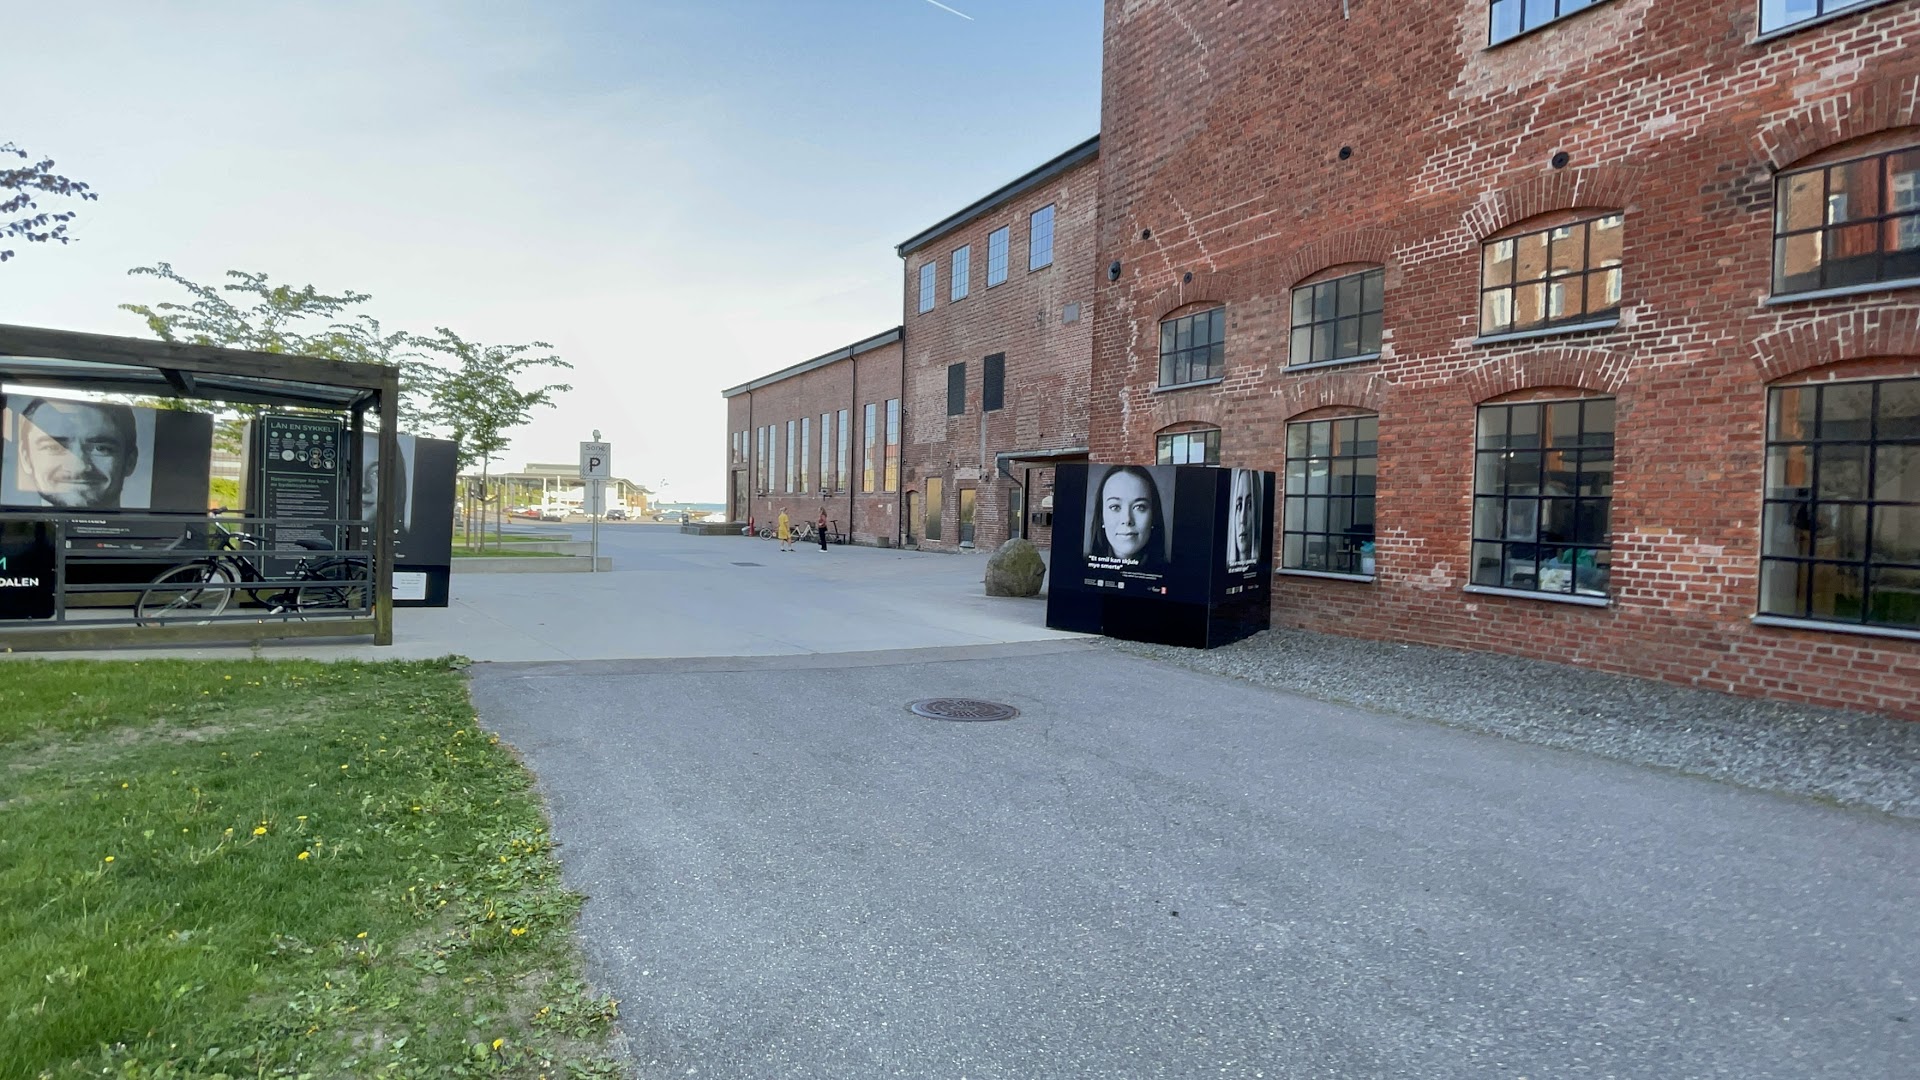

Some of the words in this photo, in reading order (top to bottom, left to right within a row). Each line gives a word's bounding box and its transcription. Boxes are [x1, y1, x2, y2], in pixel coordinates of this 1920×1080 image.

[289, 423, 301, 431] EN
[585, 444, 606, 452] Sone
[589, 457, 601, 473] P
[1121, 558, 1139, 566] skjule
